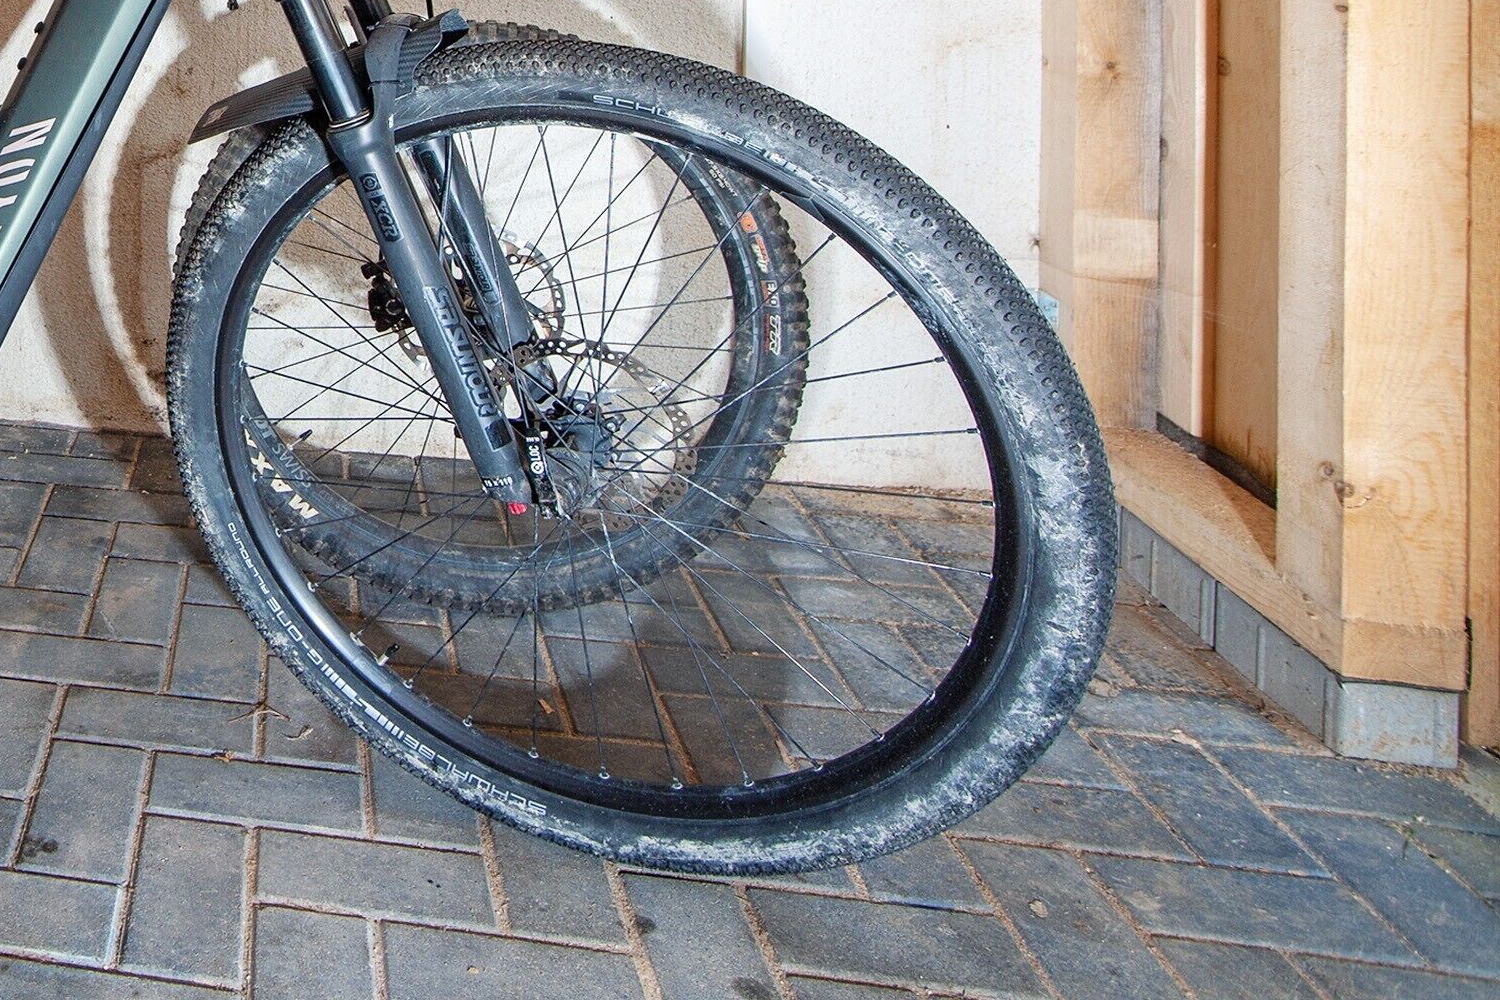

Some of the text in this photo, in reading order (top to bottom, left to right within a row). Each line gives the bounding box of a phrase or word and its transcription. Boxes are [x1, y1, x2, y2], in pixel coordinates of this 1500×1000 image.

[447, 324, 499, 418] SUNTOUR
[271, 442, 312, 489] SWISS
[227, 522, 548, 817] SCHWALBE G-ONE ALLROUND
